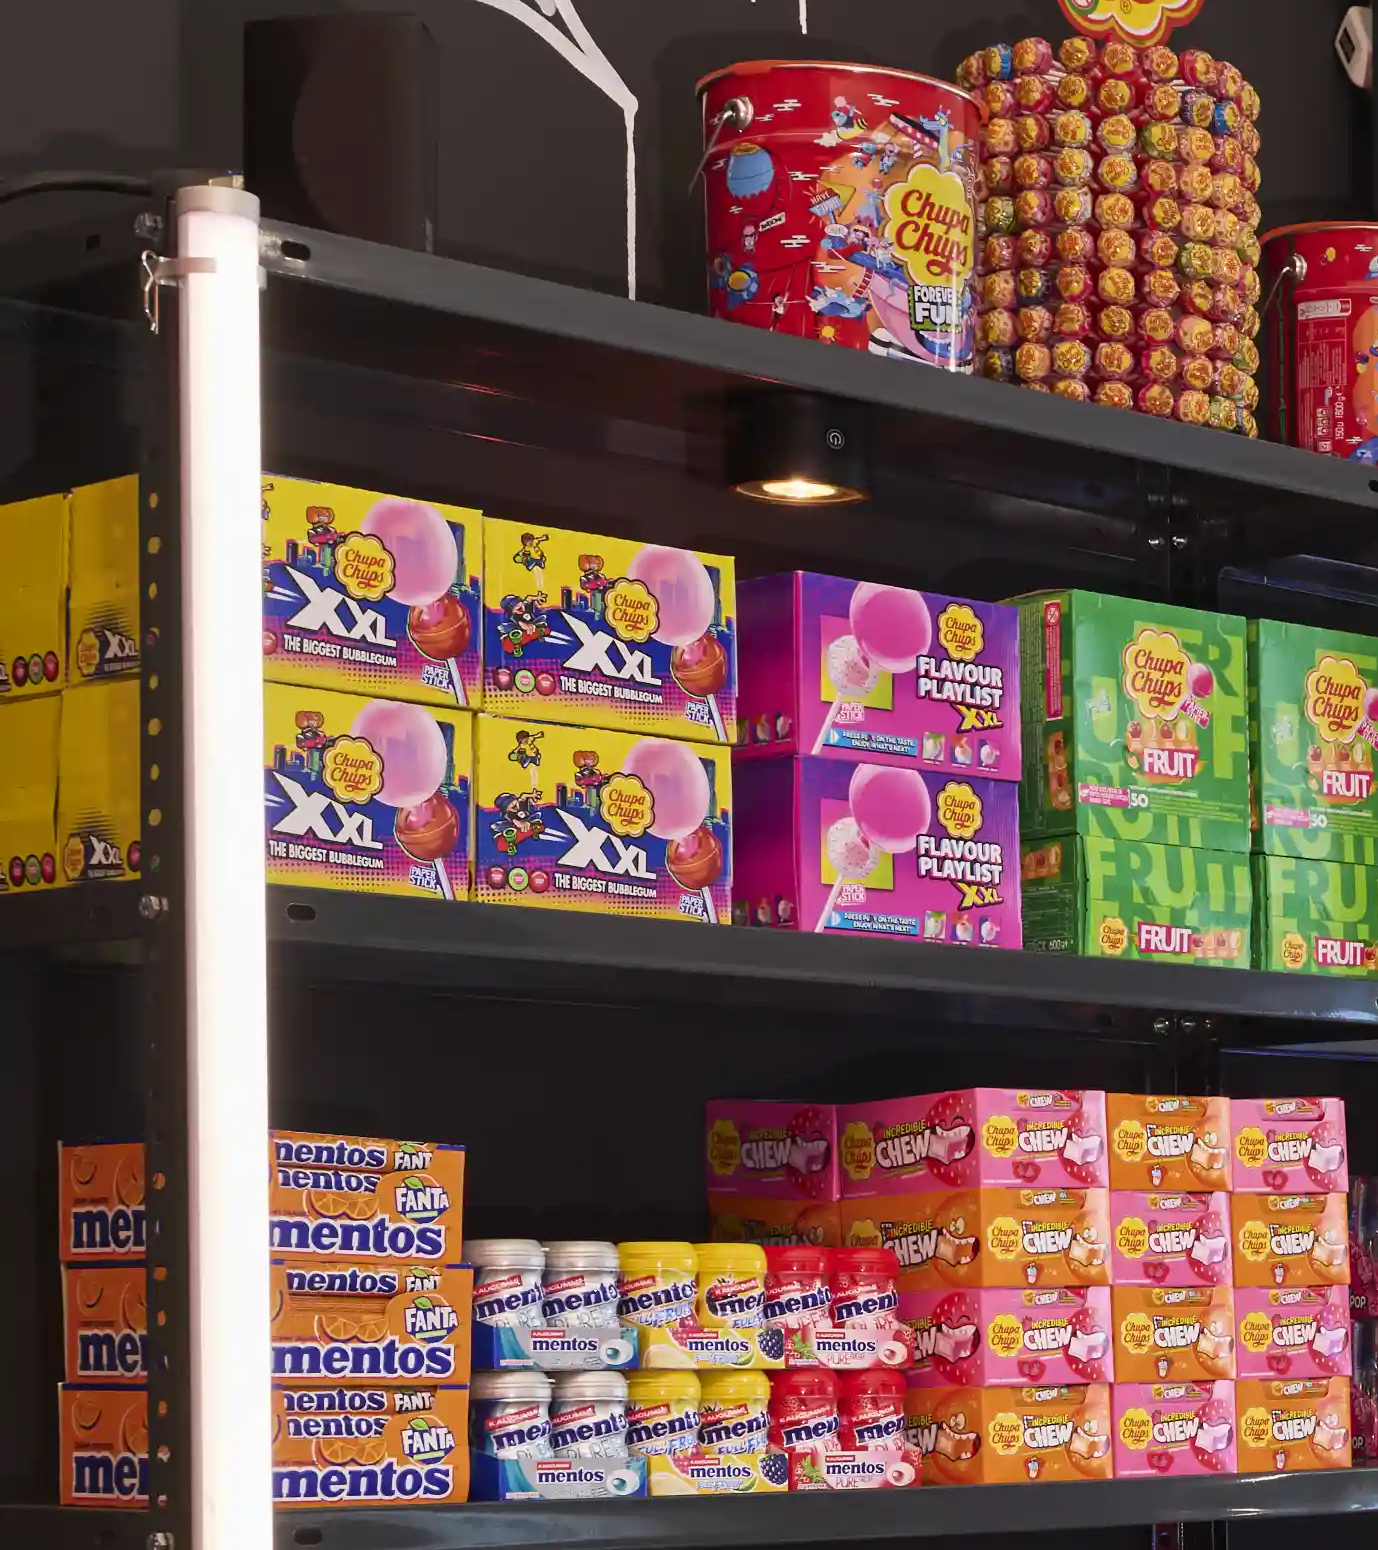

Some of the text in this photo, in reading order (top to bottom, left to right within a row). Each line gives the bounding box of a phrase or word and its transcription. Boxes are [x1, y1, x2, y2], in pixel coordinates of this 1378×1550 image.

[286, 565, 396, 647] XXL
[284, 634, 396, 666] THE BIGGEST BUBBLEGUM
[562, 612, 661, 685] XXL
[918, 656, 1003, 686] FLAVOUR
[560, 676, 662, 703] THE BIGGEST BUBBLEGUM
[918, 678, 1003, 708] PLAYLIST
[1143, 748, 1197, 778] FRUIT
[273, 772, 383, 850] XXL
[1130, 792, 1148, 807] 50
[269, 840, 383, 868] THE BIGGEST BUBBLEGUM
[556, 808, 656, 879] XXL
[918, 835, 1002, 863] FLAVOUR
[919, 858, 1002, 884] PLAYLIST
[884, 1118, 927, 1137] INCREDIBLE
[1026, 1118, 1065, 1132] INCREDIBLE
[1155, 1125, 1191, 1135] INCREDIBLE
[876, 1133, 931, 1167] CHEW
[1018, 1129, 1069, 1152] CHEW
[1146, 1133, 1195, 1157] CHEW
[1267, 1138, 1313, 1162] CHEW
[396, 1185, 450, 1212] FANTA
[1022, 1231, 1073, 1254] CHEW
[405, 1306, 458, 1332] FANTA
[532, 1337, 598, 1351] mentos
[688, 1338, 749, 1351] mentos
[817, 1340, 876, 1351] mentos
[538, 1469, 604, 1483] mentos
[690, 1465, 751, 1478] mentos
[826, 1462, 884, 1476] mentos
